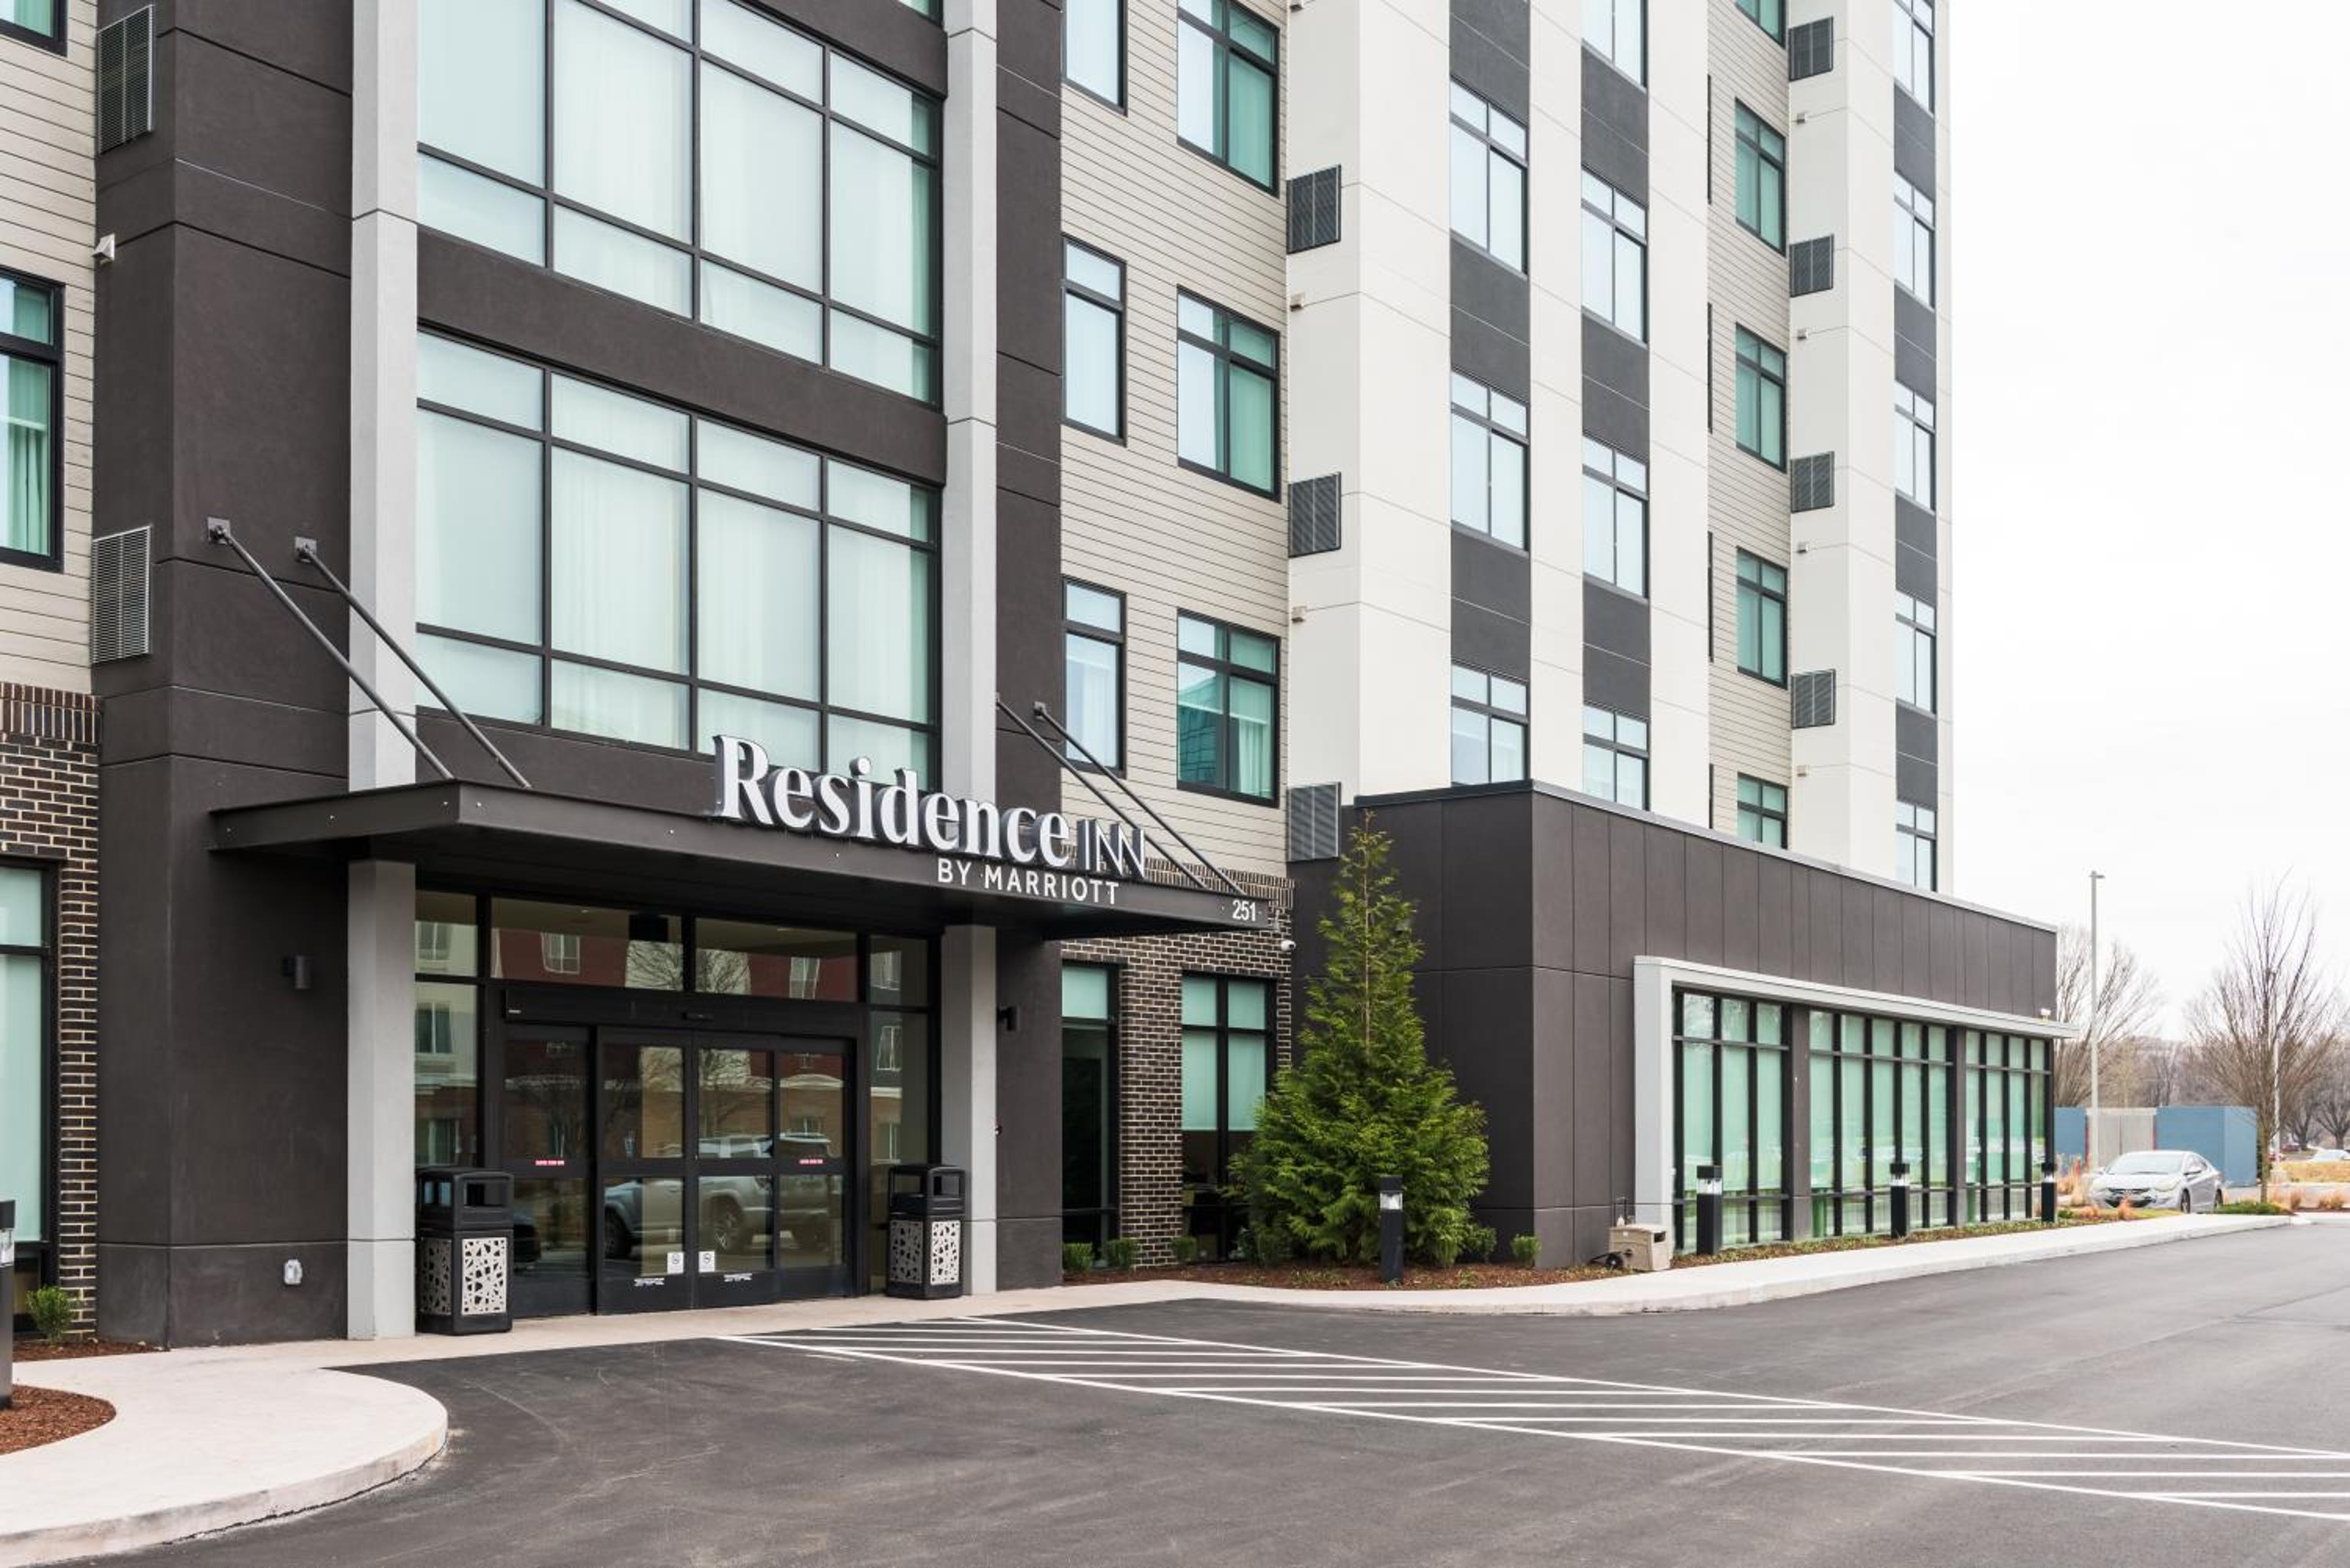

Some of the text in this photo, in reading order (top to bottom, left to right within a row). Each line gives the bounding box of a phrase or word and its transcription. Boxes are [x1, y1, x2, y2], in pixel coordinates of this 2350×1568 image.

[714, 735, 1144, 879] Residence INN
[938, 858, 1119, 905] BY MARRIOTT
[1232, 899, 1256, 922] 251
